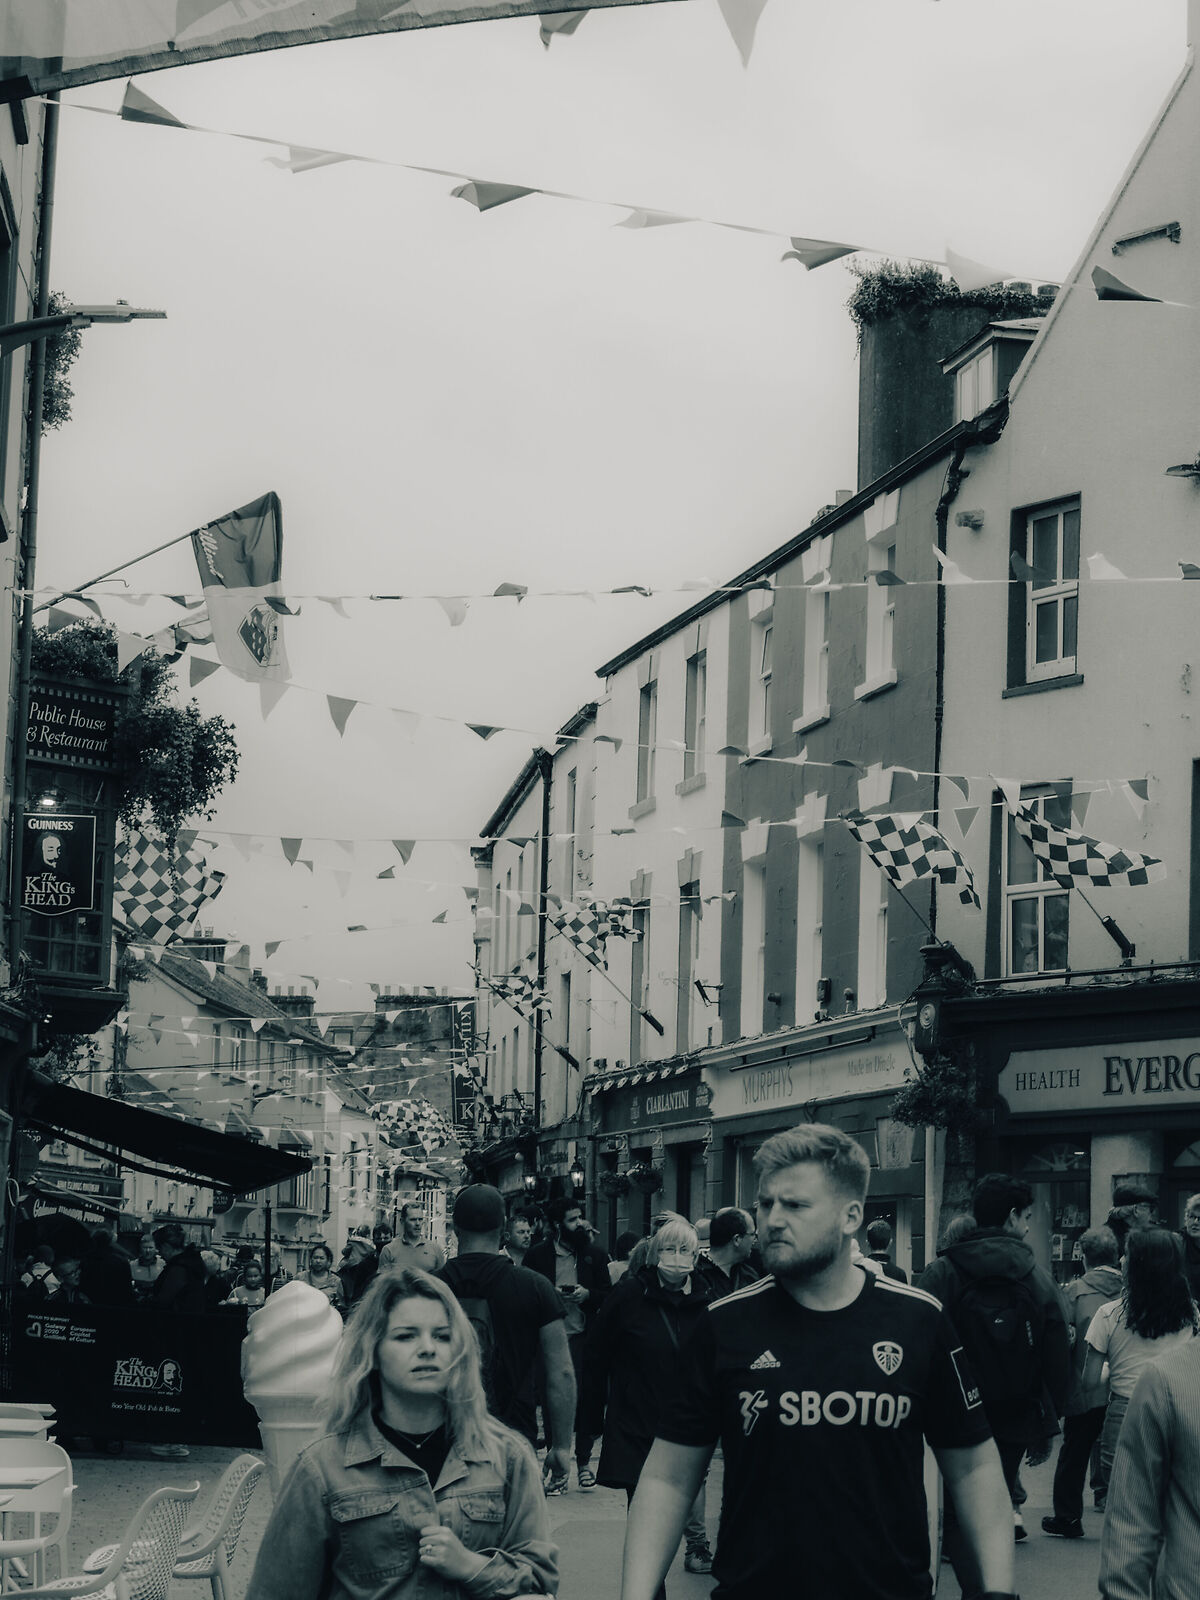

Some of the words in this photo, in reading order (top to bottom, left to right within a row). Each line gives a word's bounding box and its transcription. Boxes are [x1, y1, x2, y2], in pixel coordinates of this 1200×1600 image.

[29, 701, 67, 725] Public
[69, 708, 108, 731] House
[26, 725, 38, 743] &
[39, 725, 109, 752] Restaurant
[28, 818, 75, 831] GUINNESS
[41, 872, 57, 882] The
[24, 893, 72, 907] HEAD
[742, 1061, 794, 1105] MURPHY'S
[1015, 1068, 1081, 1092] HEALTH
[44, 1323, 66, 1332] Galway
[70, 1325, 97, 1333] European
[750, 1360, 781, 1370] adidas
[113, 1374, 154, 1389] HEAD
[779, 1390, 912, 1429] SBOTOP
